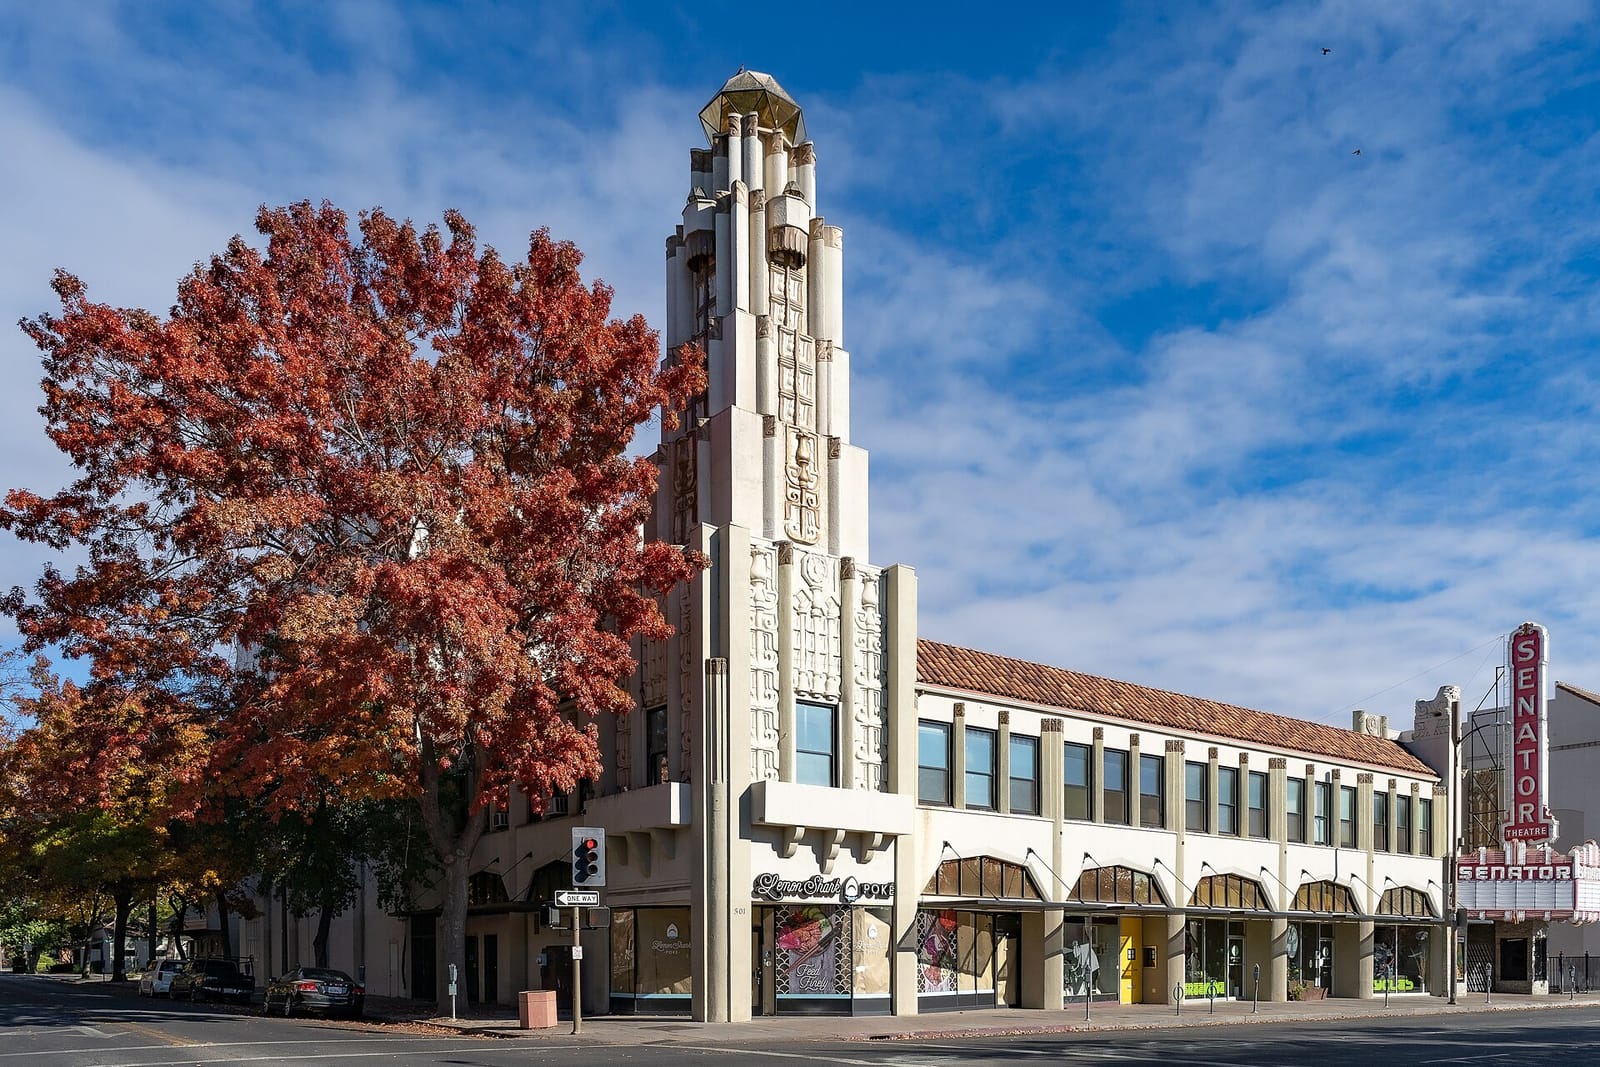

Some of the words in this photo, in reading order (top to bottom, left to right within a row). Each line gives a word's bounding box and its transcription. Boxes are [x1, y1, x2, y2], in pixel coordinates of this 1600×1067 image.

[1515, 639, 1537, 824] SENATOR
[1506, 826, 1548, 837] THEATRE
[1459, 866, 1571, 879] SENATOR
[758, 873, 804, 900] Lemon
[804, 875, 840, 895] Shark
[734, 907, 746, 915] 501
[796, 964, 821, 977] Feed
[800, 975, 829, 990] Finely
